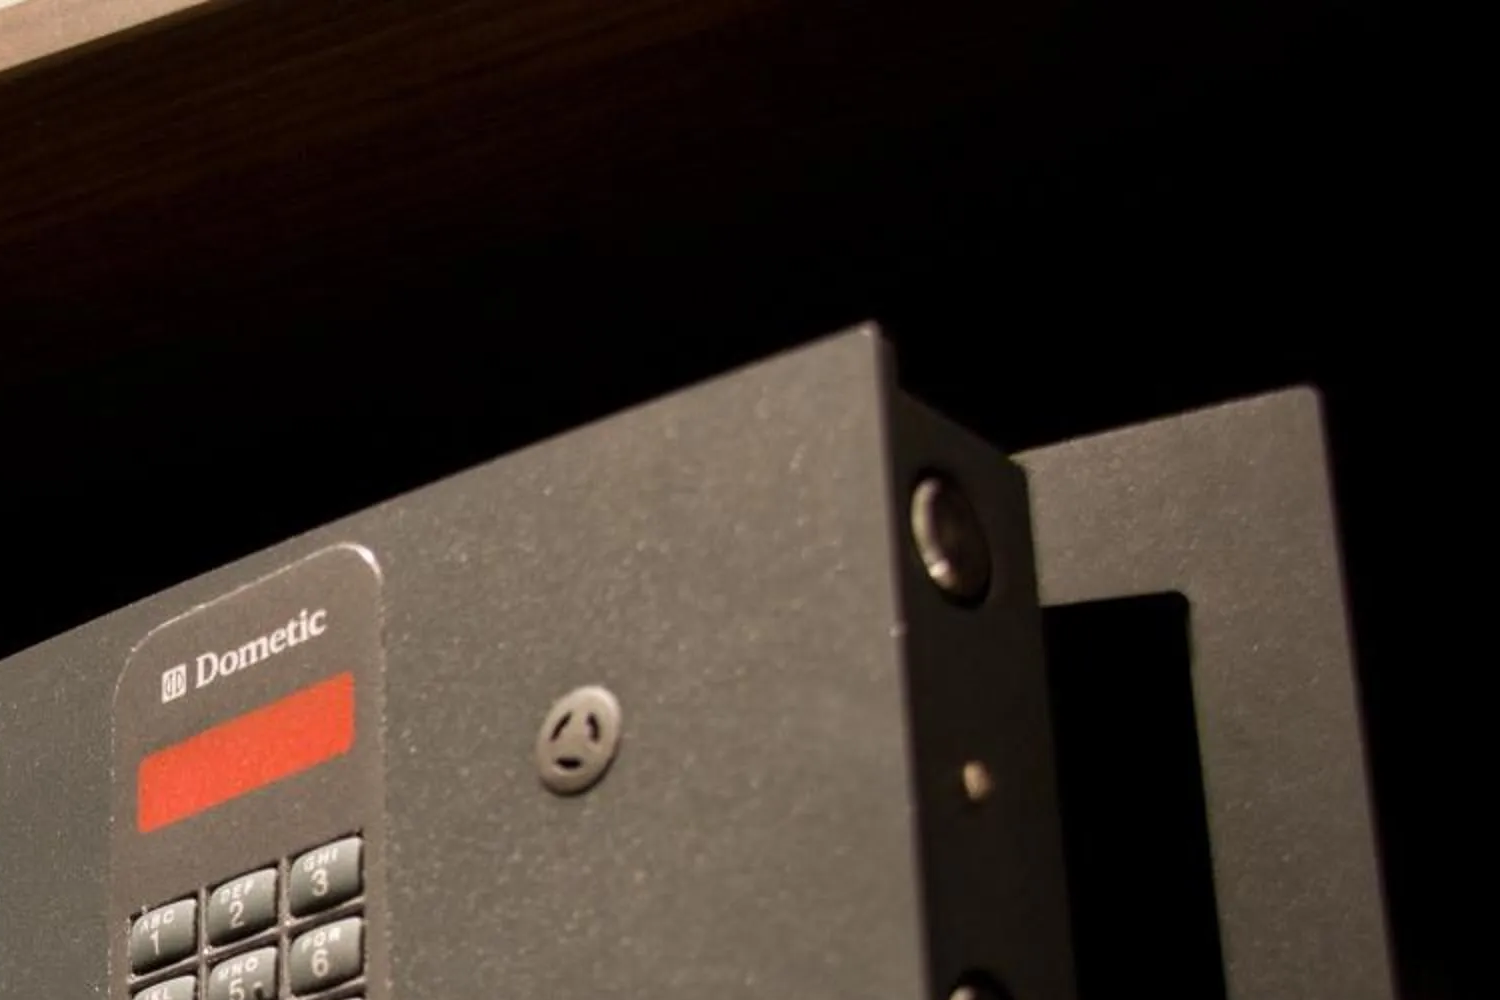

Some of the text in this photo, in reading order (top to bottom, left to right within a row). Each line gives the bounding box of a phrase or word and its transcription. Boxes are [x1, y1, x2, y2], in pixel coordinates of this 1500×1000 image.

[196, 609, 327, 688] Dometic
[220, 879, 255, 905] DEF
[311, 869, 328, 896] 3
[229, 900, 244, 928] 2
[150, 931, 160, 955] 1
[312, 948, 328, 978] 6
